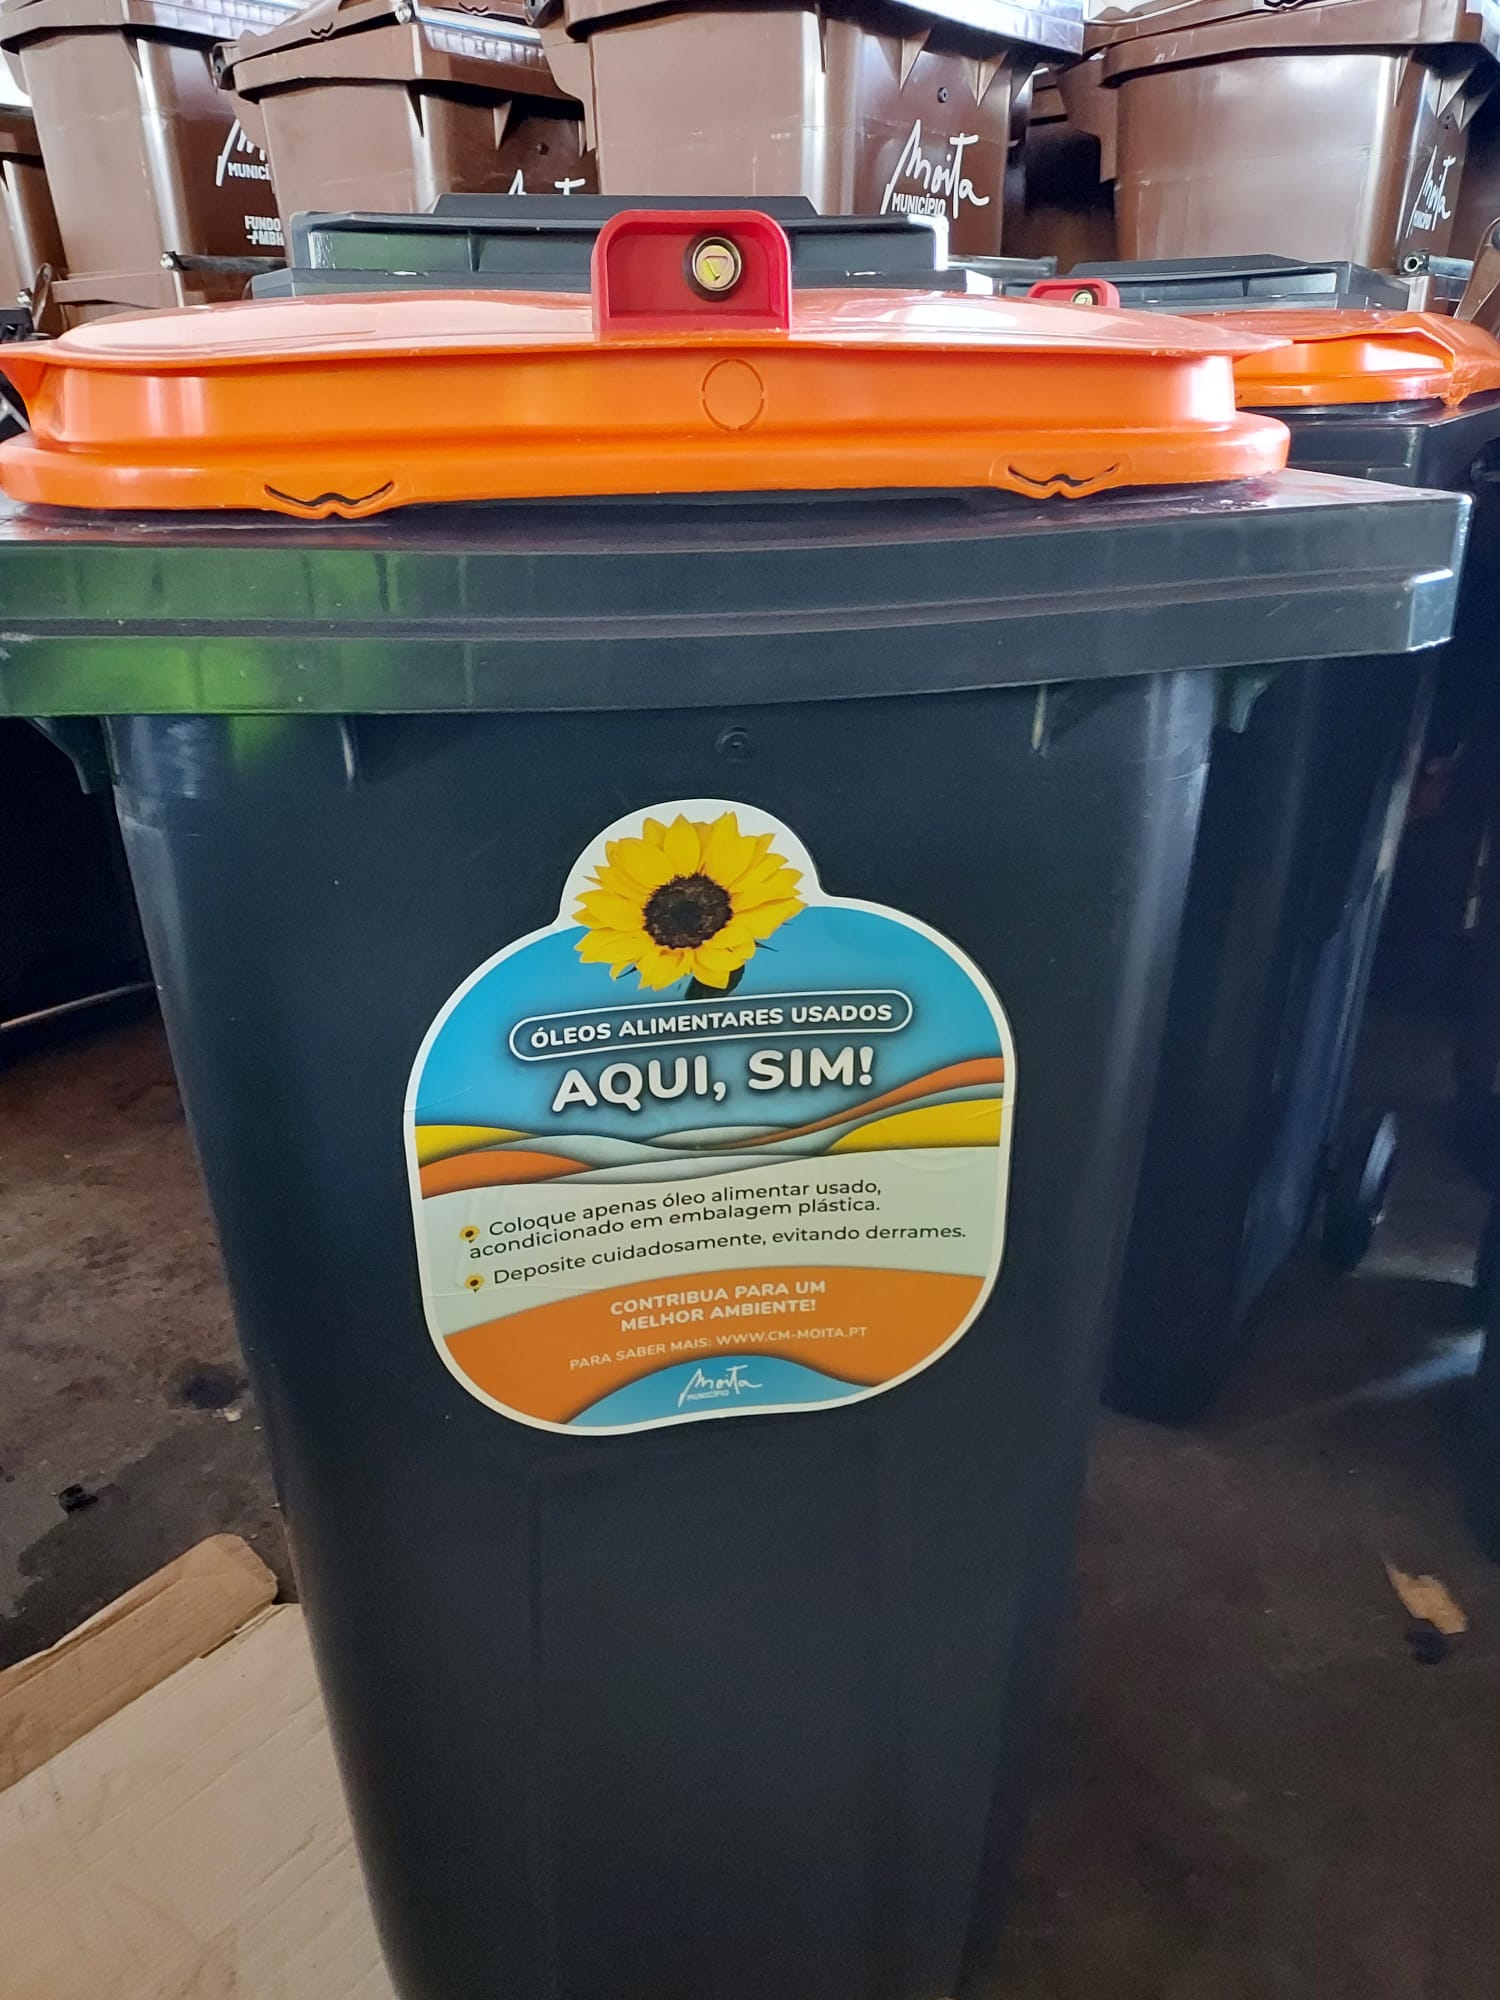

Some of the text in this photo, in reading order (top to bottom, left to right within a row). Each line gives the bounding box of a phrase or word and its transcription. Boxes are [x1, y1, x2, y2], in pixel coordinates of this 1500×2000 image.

[227, 161, 272, 181] MUNICÍ
[244, 215, 281, 231] FUNDO
[891, 193, 946, 215] MUNICÍPIO
[531, 1004, 893, 1049] ÓLEOS ALIMENTARES USADOS
[551, 1046, 875, 1113] AQUI, SIM!
[469, 1197, 881, 1259] acondicionado em embalagem plástica.
[489, 1179, 882, 1236] Coloque apenas óleo alimentar usado,
[494, 1225, 967, 1285] Deposite cuidadosamente, evitando derrames.
[610, 1280, 826, 1316] CONTRIBUA PARA UM
[620, 1299, 817, 1332] MELHOR AMBIENTE!
[569, 1326, 868, 1370] PARA SABER MAIS: WWW.CM-MOITA.PT
